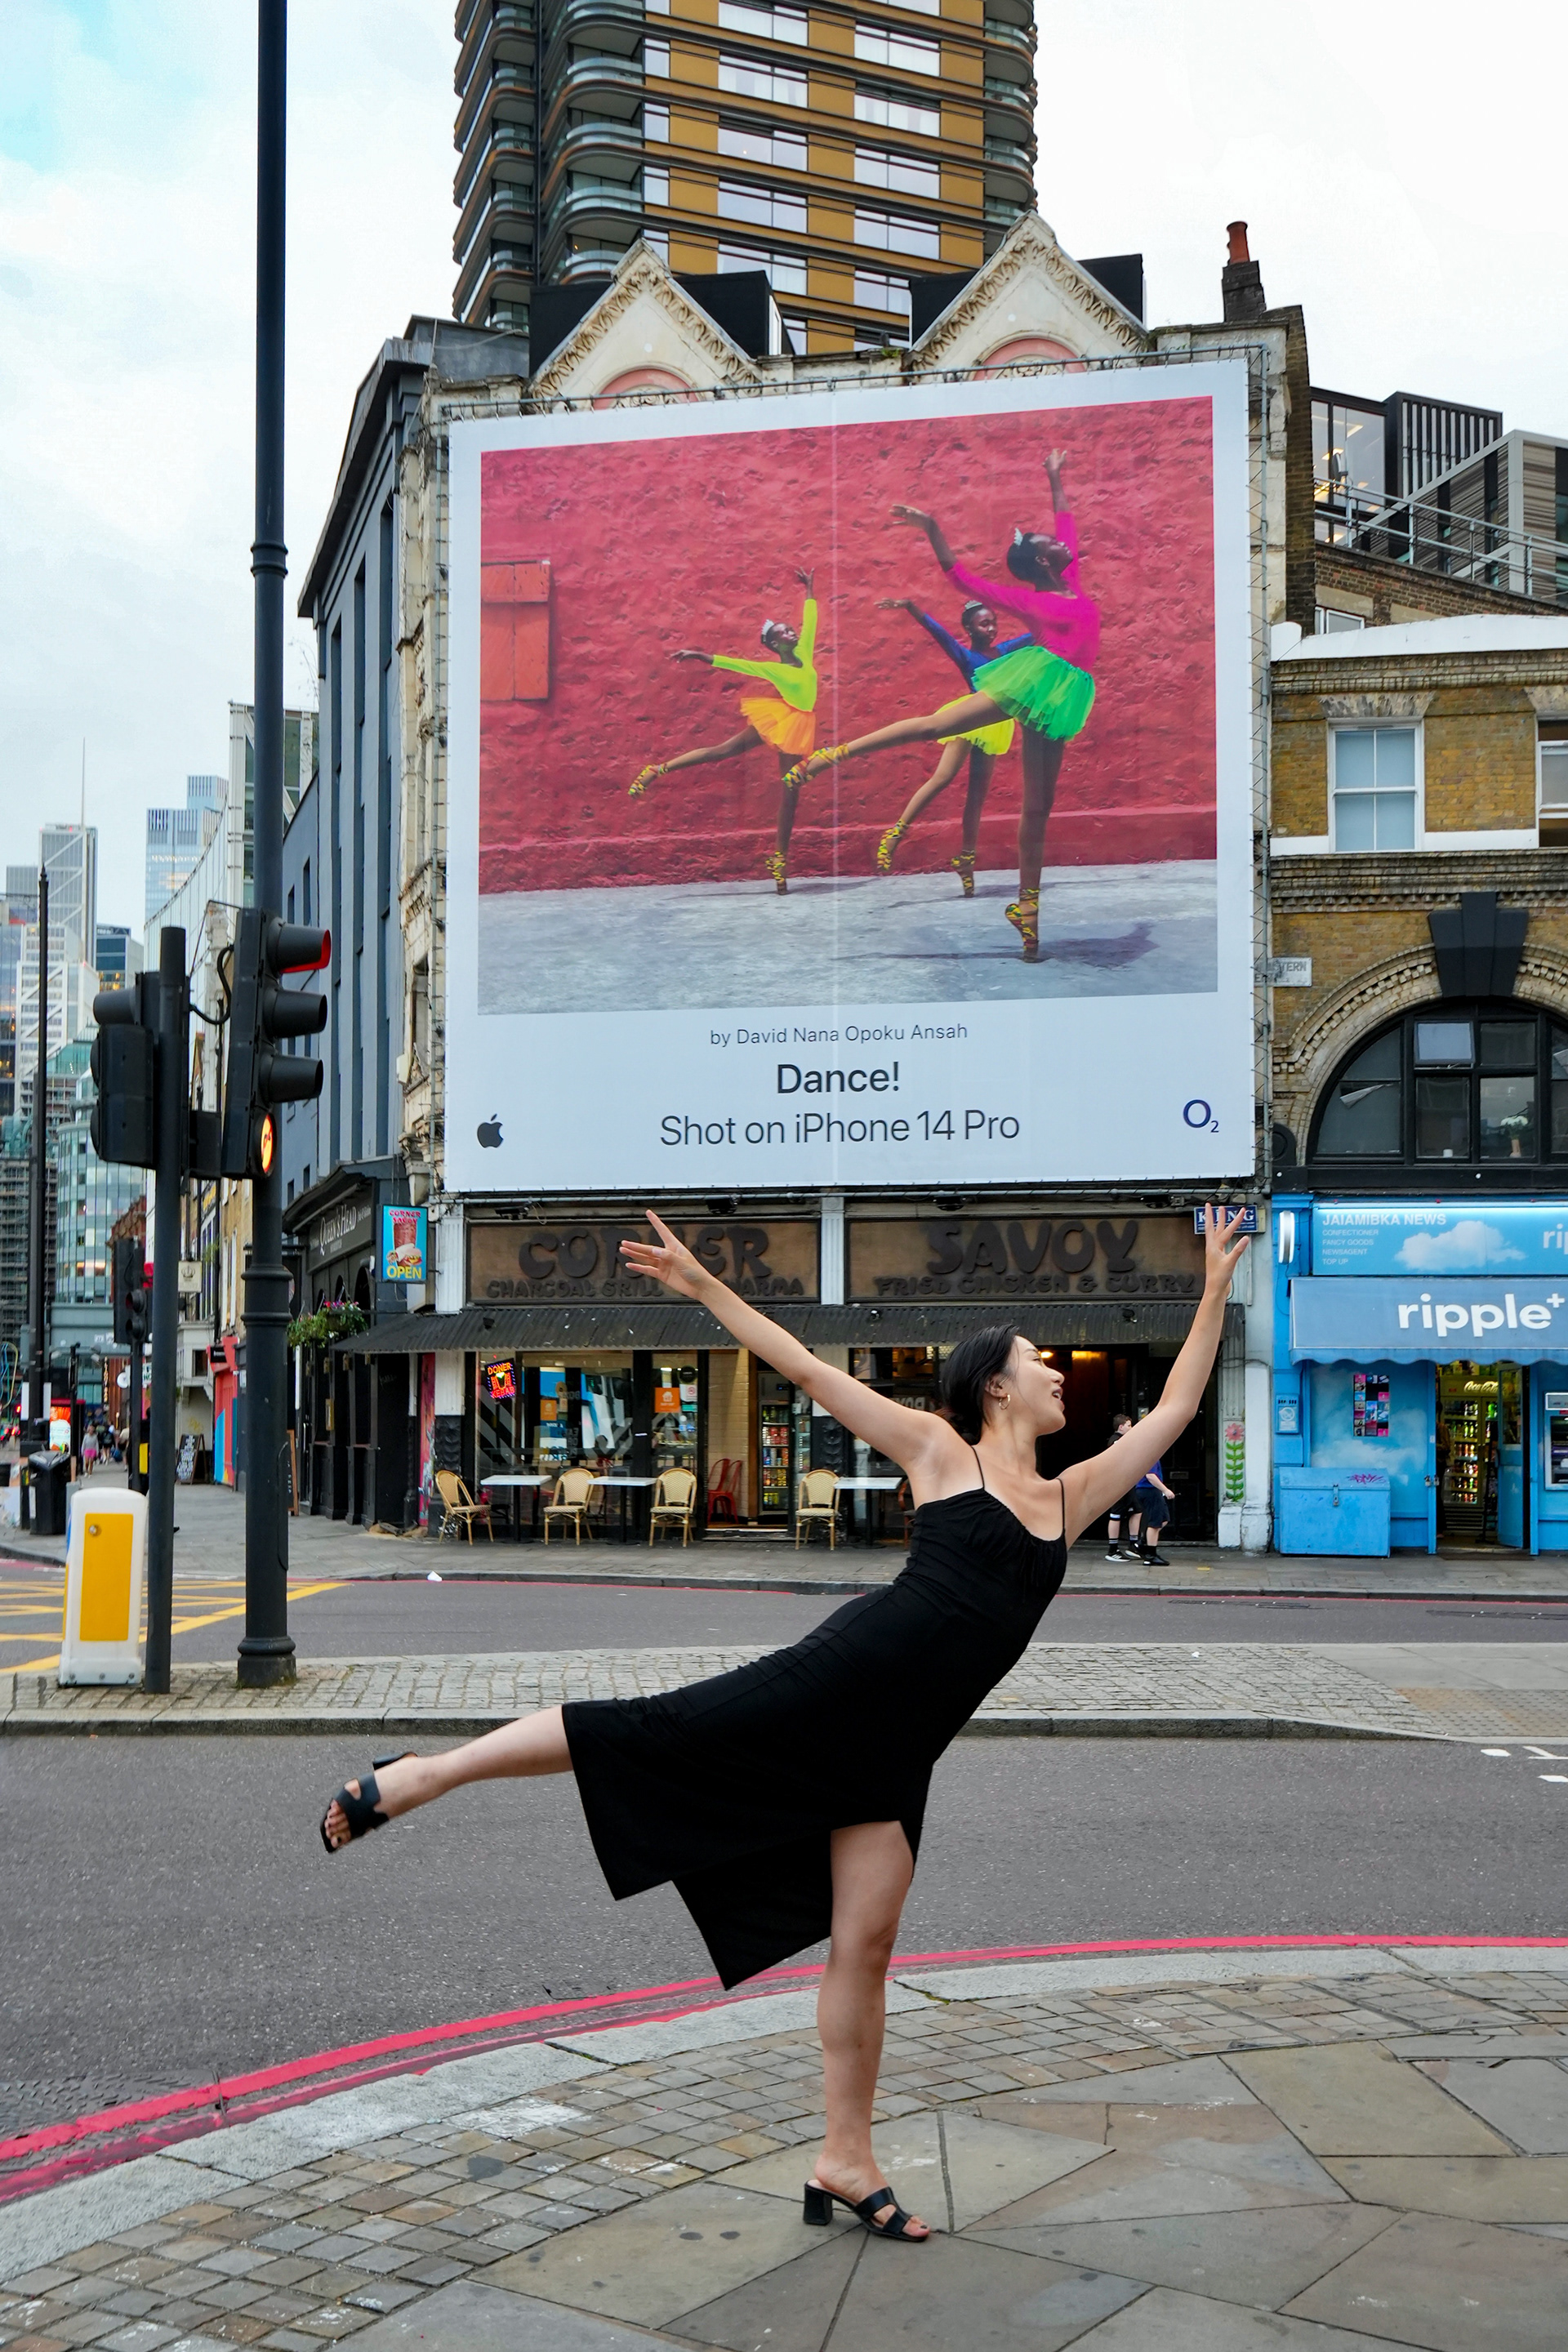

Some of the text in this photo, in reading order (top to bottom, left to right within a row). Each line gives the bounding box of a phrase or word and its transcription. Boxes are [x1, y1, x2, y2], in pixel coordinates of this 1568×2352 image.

[710, 1022, 968, 1048] by David Nana Opoku Ansah
[777, 1061, 900, 1094] Dance!
[660, 1109, 1020, 1146] Shot on iPhone 14 Pro
[1404, 1213, 1446, 1226] NEWS
[924, 1220, 1139, 1275] SAVOY
[386, 1264, 422, 1280] OPEN
[486, 1277, 596, 1299] CHARCOAL
[600, 1276, 664, 1298] GRILL
[874, 1273, 1196, 1297] FRIED CHICKEN & CURRY
[487, 1361, 512, 1375] DONER
[491, 1385, 516, 1399] KEBAB
